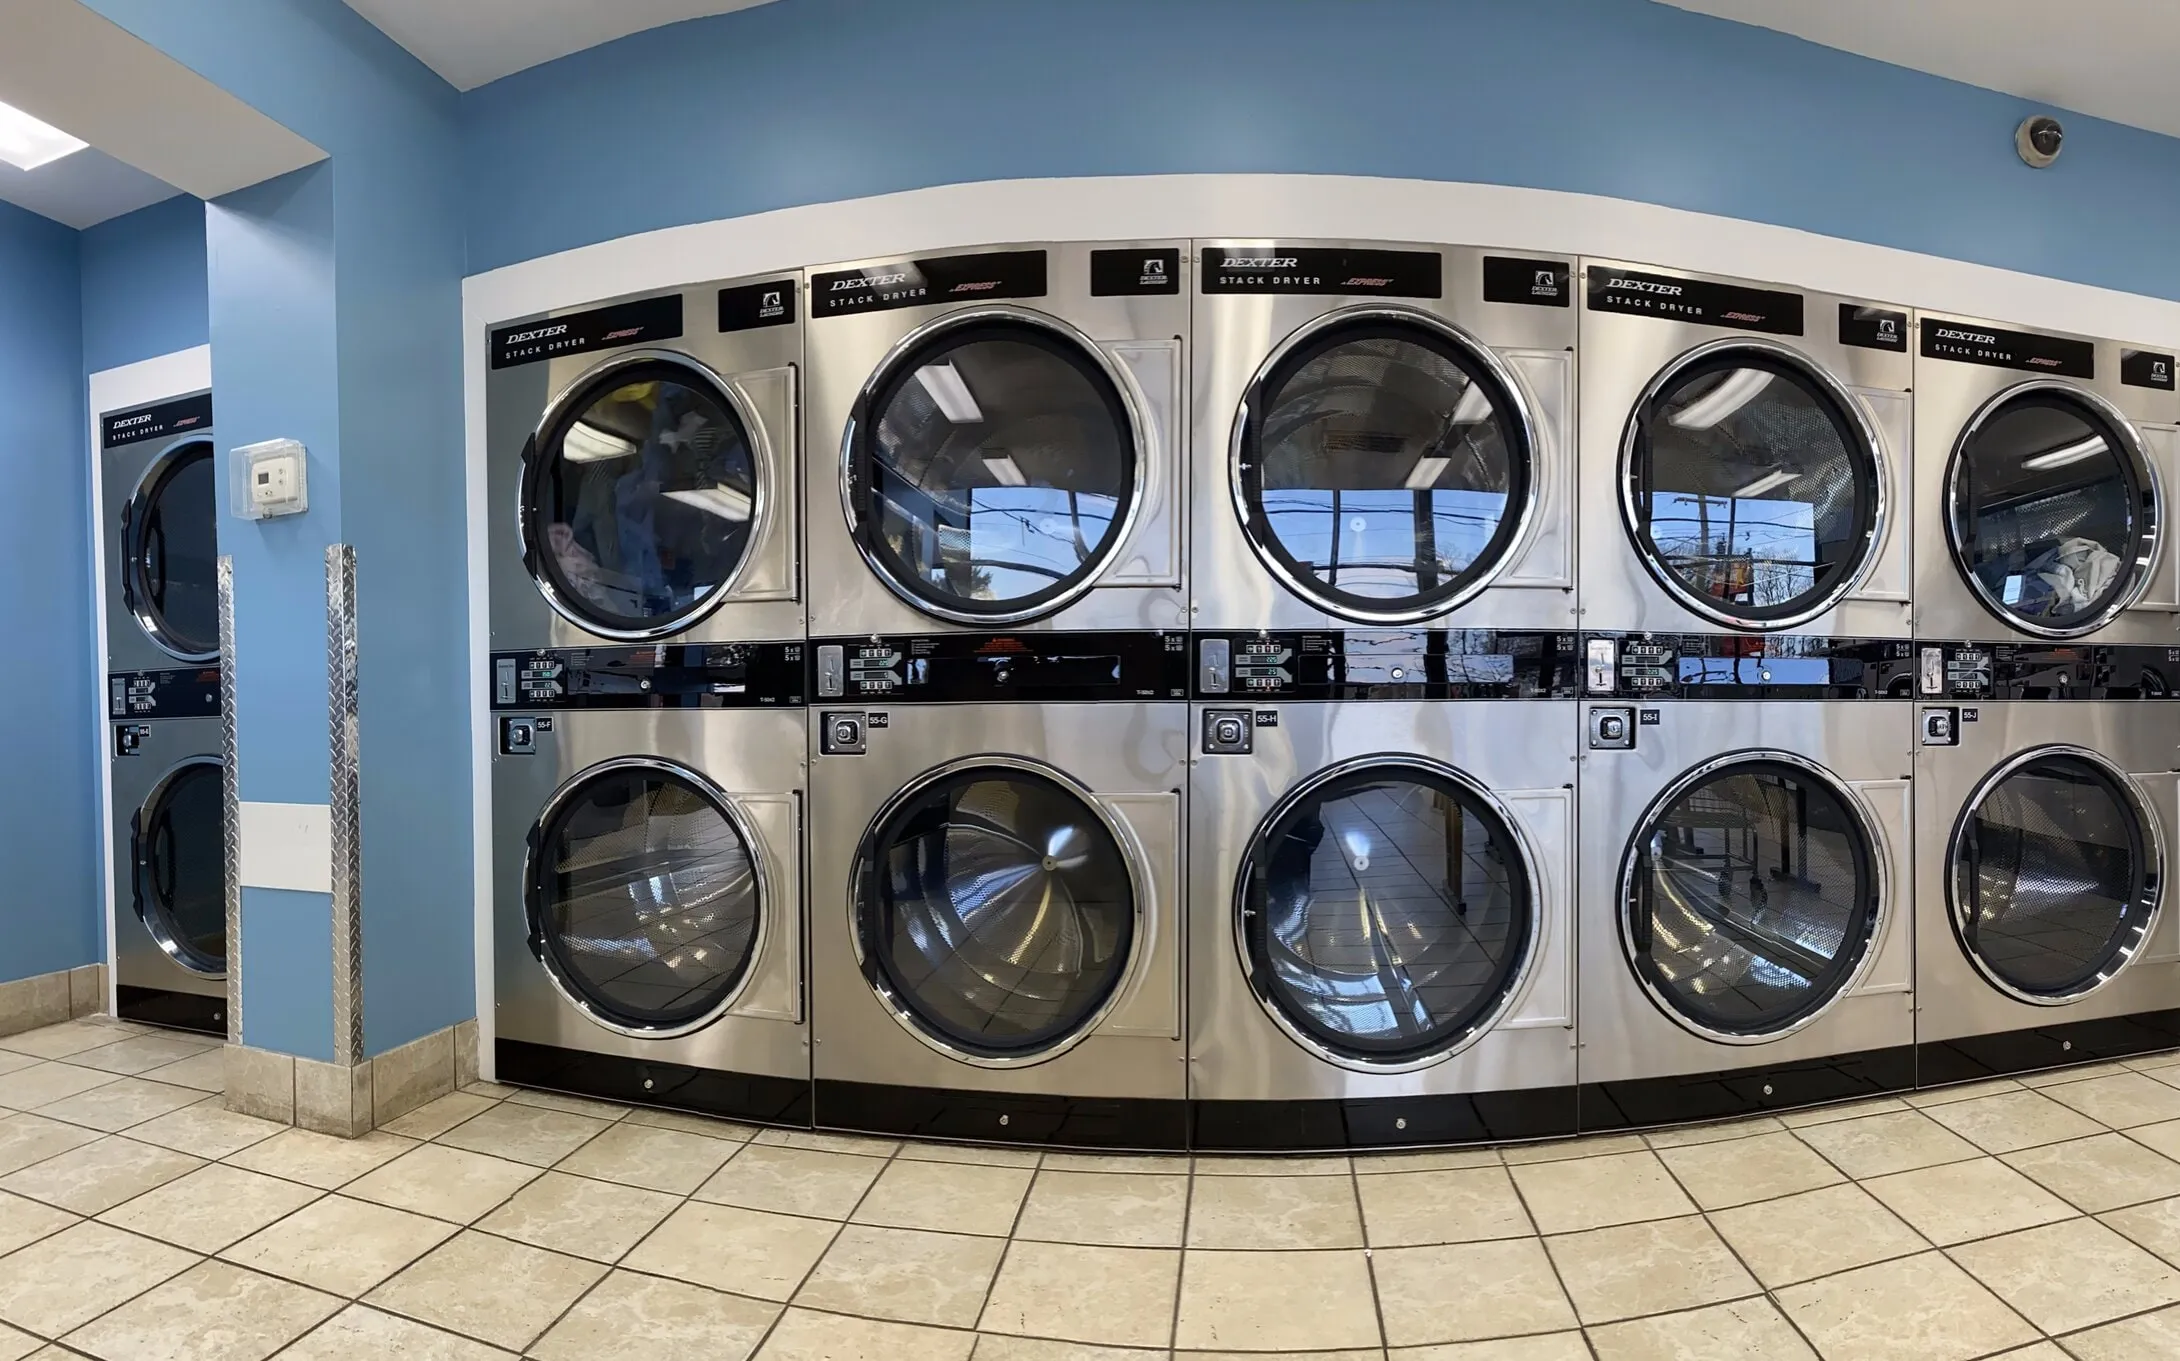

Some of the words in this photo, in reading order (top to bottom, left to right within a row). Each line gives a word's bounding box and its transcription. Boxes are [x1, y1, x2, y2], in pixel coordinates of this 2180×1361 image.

[1220, 257, 1298, 268] DEXTER
[829, 273, 906, 291] DEXTER
[1219, 276, 1265, 285] STACK
[1273, 276, 1320, 285] DRYER
[1606, 278, 1682, 296] DEXTER
[829, 295, 874, 308] STACK
[882, 287, 927, 301] DRYER
[1606, 295, 1651, 308] STACK
[1659, 302, 1703, 315] DRYER
[506, 324, 568, 345] DEXTER
[1935, 328, 1995, 344] DEXTER
[505, 346, 541, 359] STACK
[548, 337, 585, 351] DRYER
[1935, 344, 1971, 355] STACK
[1978, 350, 2012, 361] DRYER
[113, 414, 151, 430] DEXTER
[113, 430, 136, 441] STACK
[139, 424, 164, 435] DRYER
[869, 716, 887, 724] 55-G
[1256, 715, 1277, 723] 55-H
[1643, 713, 1658, 721] 55-I
[1964, 711, 1977, 719] 55-J
[537, 720, 551, 729] 55-F
